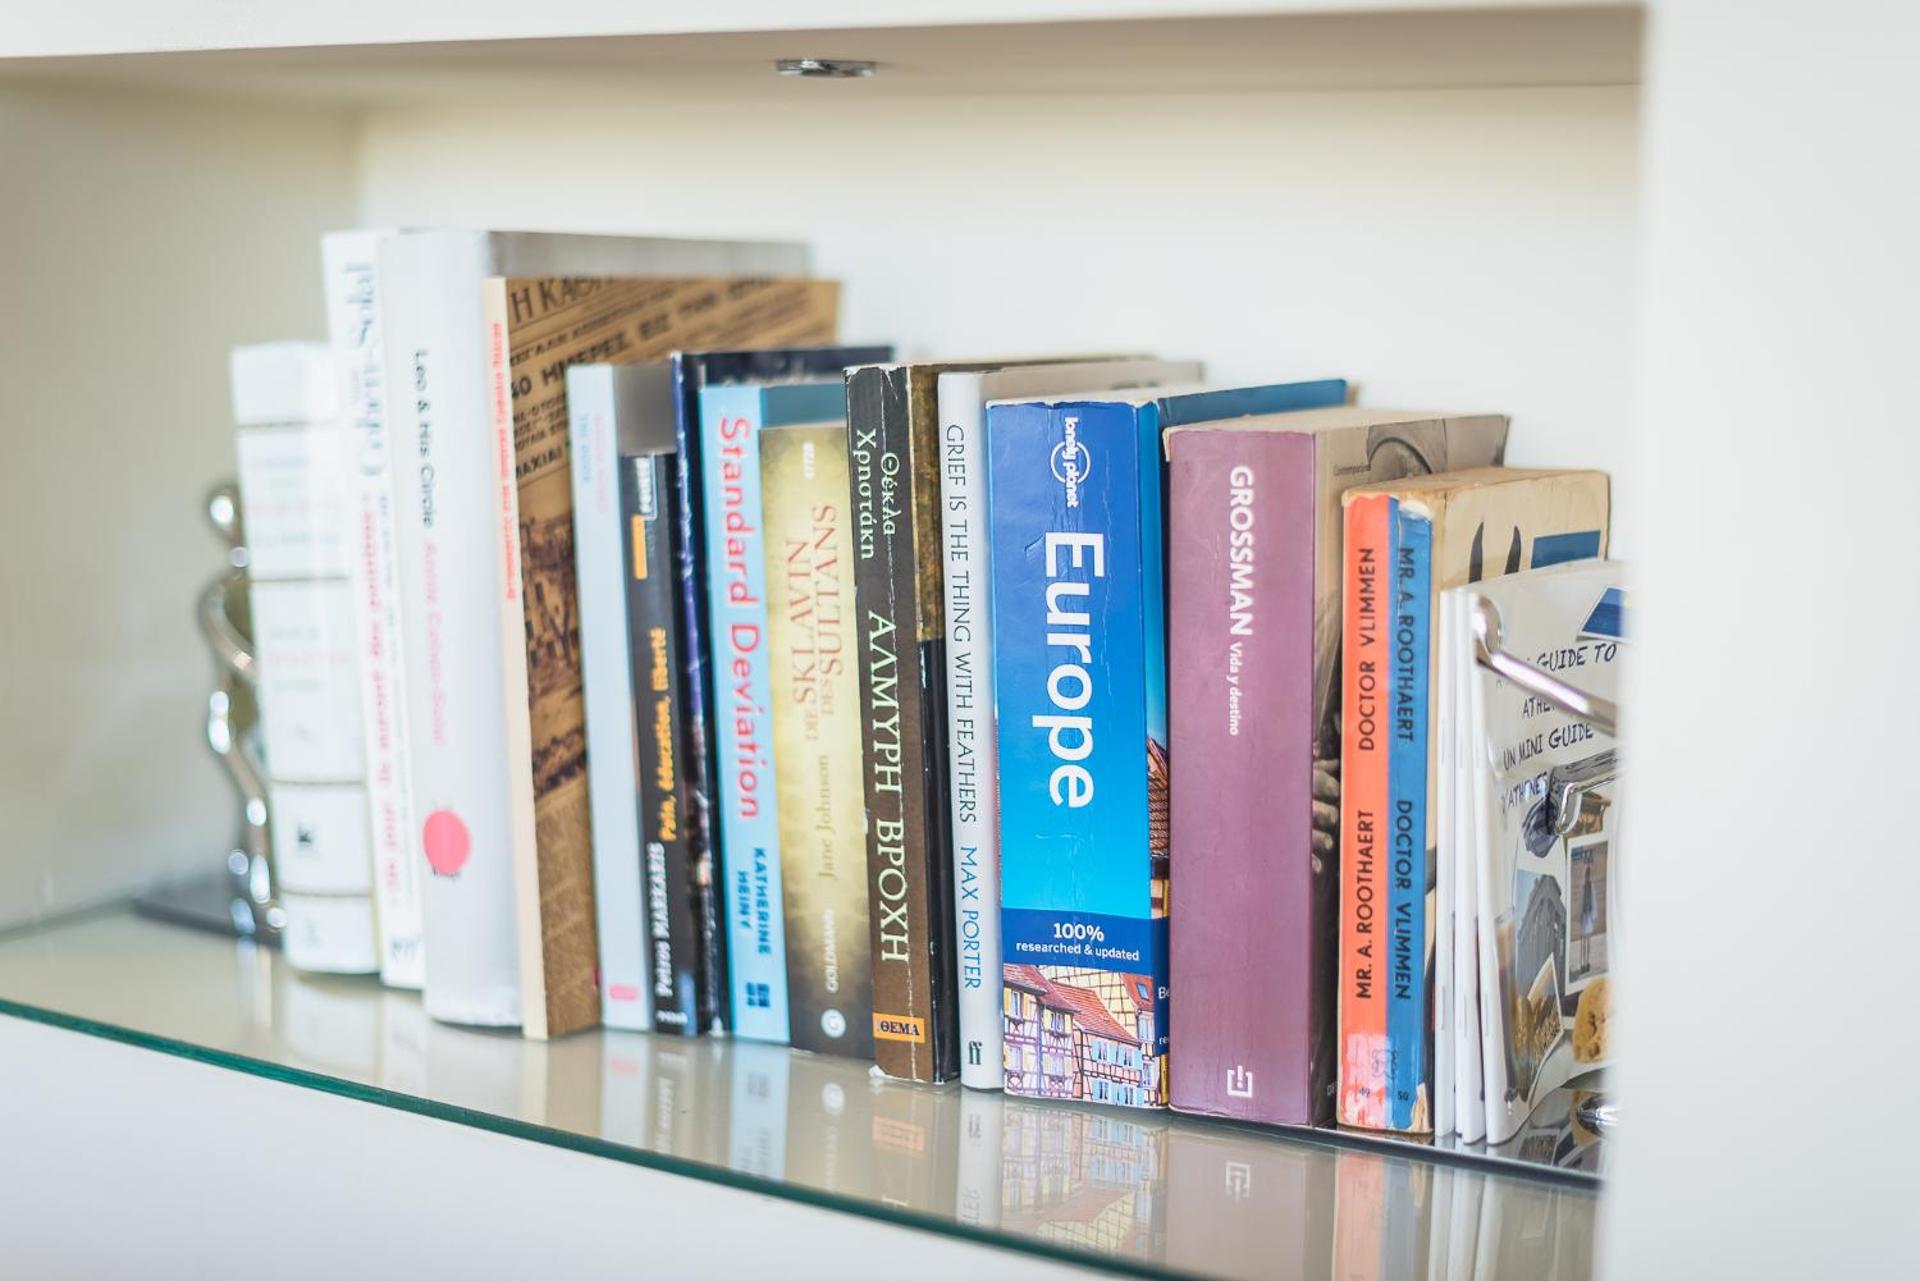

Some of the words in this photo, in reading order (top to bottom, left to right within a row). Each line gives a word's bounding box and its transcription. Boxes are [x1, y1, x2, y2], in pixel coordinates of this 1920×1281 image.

[415, 350, 428, 391] Leo
[417, 399, 431, 413] &
[419, 422, 431, 457] His
[946, 424, 966, 486] GRIEF
[1062, 417, 1079, 460] lonely
[421, 464, 435, 528] Circle
[720, 417, 760, 608] Standard
[853, 428, 878, 560] Χρηστάκη
[880, 452, 902, 535] Θέκλα
[949, 496, 967, 511] IS
[1063, 462, 1079, 508] planet
[950, 520, 969, 561] THE
[1229, 465, 1254, 636] GROSSMAN
[1400, 549, 1415, 585] MR.
[812, 504, 844, 677] SULTANS
[952, 571, 971, 642] THING
[1359, 549, 1376, 646] VLIMMEN
[1400, 591, 1414, 610] A.
[785, 540, 816, 704] SKLAVIN
[955, 652, 974, 709] WITH
[1032, 532, 1105, 808] Europe
[1227, 675, 1239, 685] y
[1230, 641, 1243, 674] Vida
[1397, 614, 1414, 742] ROOTHAERT
[1537, 646, 1589, 672] GUIDE
[1594, 643, 1618, 663] TO
[731, 623, 768, 818] Deviation
[868, 610, 903, 793] ΑΛΜΥΡΗ
[1229, 686, 1243, 736] destino
[1359, 661, 1376, 750] DOCTOR
[1522, 696, 1557, 719] ATHE
[957, 719, 976, 823] FEATHERS
[1503, 746, 1516, 771] UN
[1518, 734, 1543, 762] MINI
[1548, 722, 1594, 750] GUIDE
[960, 847, 979, 900] MAX
[1356, 810, 1374, 933] ROOTHAERT
[1396, 800, 1413, 889] DOCTOR
[737, 870, 752, 929] HEINY
[754, 847, 773, 955] KATHERINE
[876, 818, 909, 963] ΒΡΟΧΗ
[962, 909, 981, 989] PORTER
[1016, 941, 1082, 955] researched
[1083, 944, 1094, 956] &
[1095, 948, 1140, 961] updated
[1053, 922, 1105, 942] 100%
[1357, 937, 1373, 958] A.
[1396, 902, 1412, 1000] VLIMMEN
[1354, 964, 1372, 999] MR.
